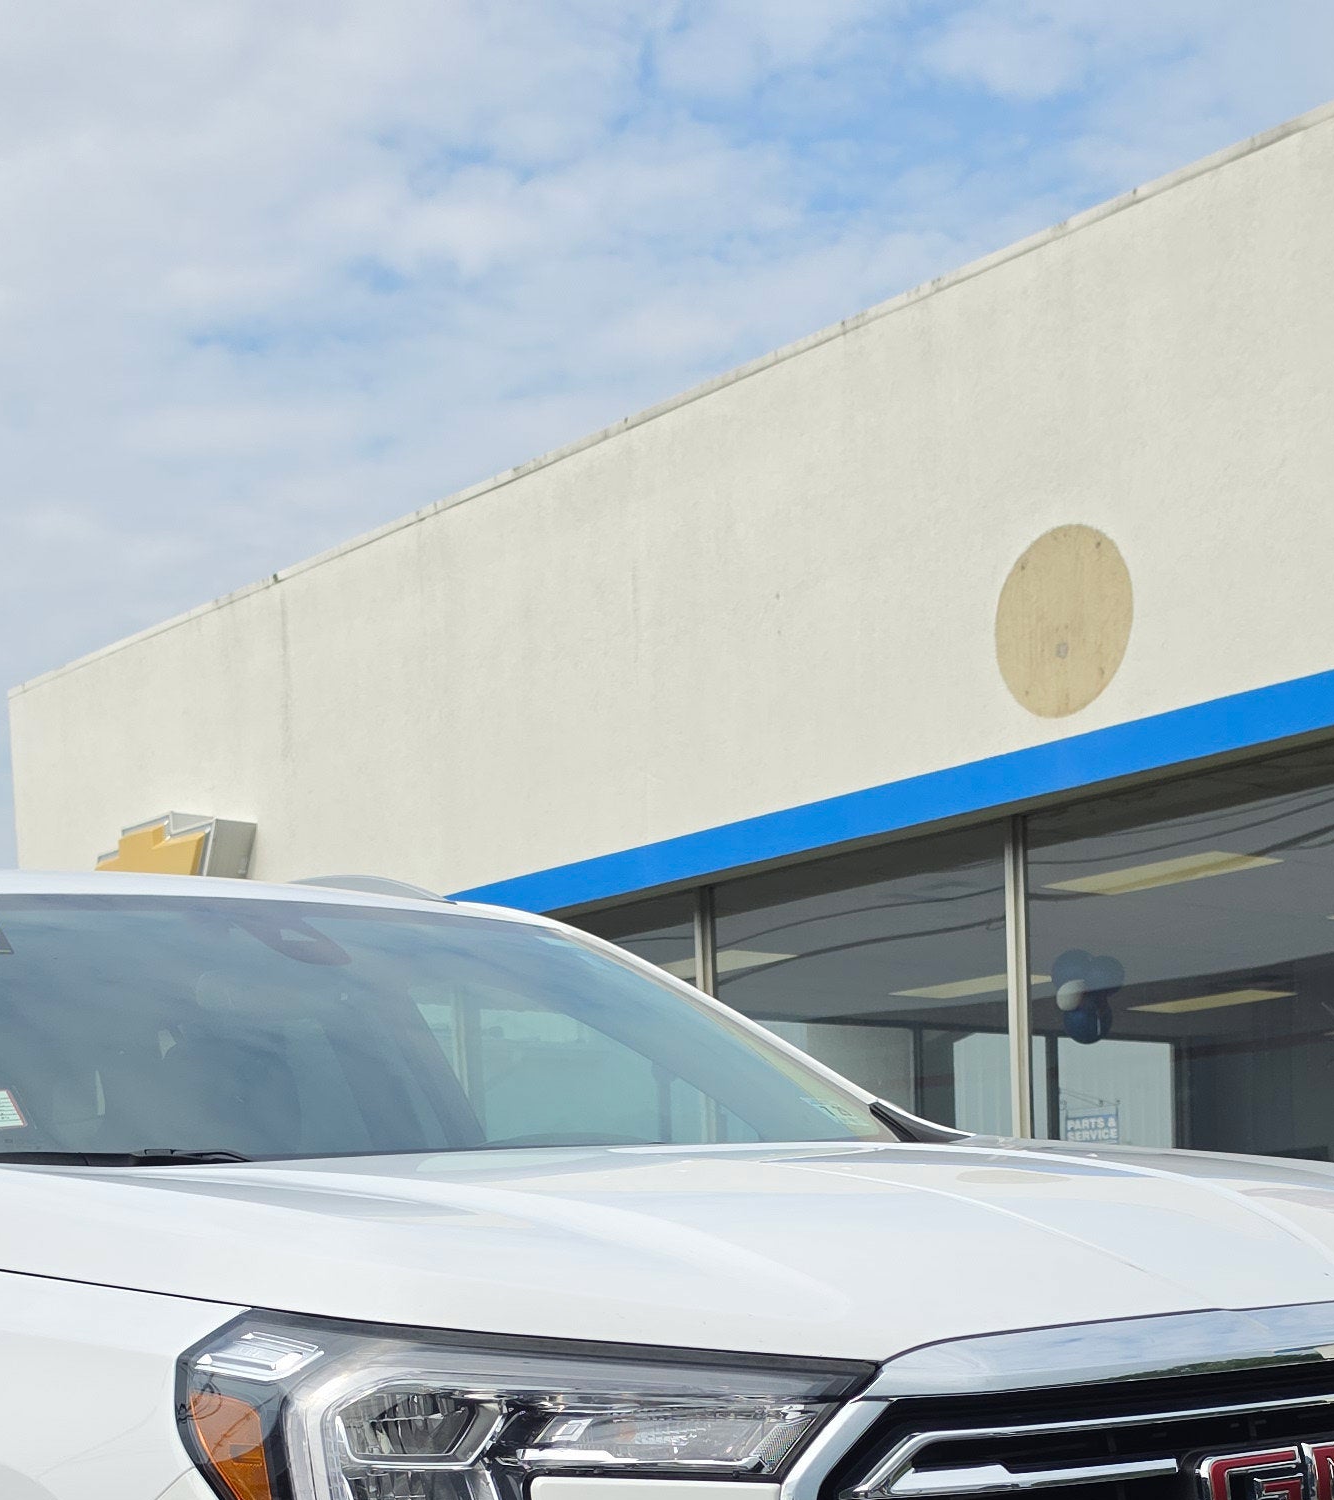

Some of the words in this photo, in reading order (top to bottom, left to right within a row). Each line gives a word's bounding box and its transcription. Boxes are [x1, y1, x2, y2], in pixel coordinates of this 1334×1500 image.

[1067, 1116, 1105, 1131] PARTS
[1108, 1116, 1117, 1128] &
[1067, 1127, 1119, 1142] SERVICE
